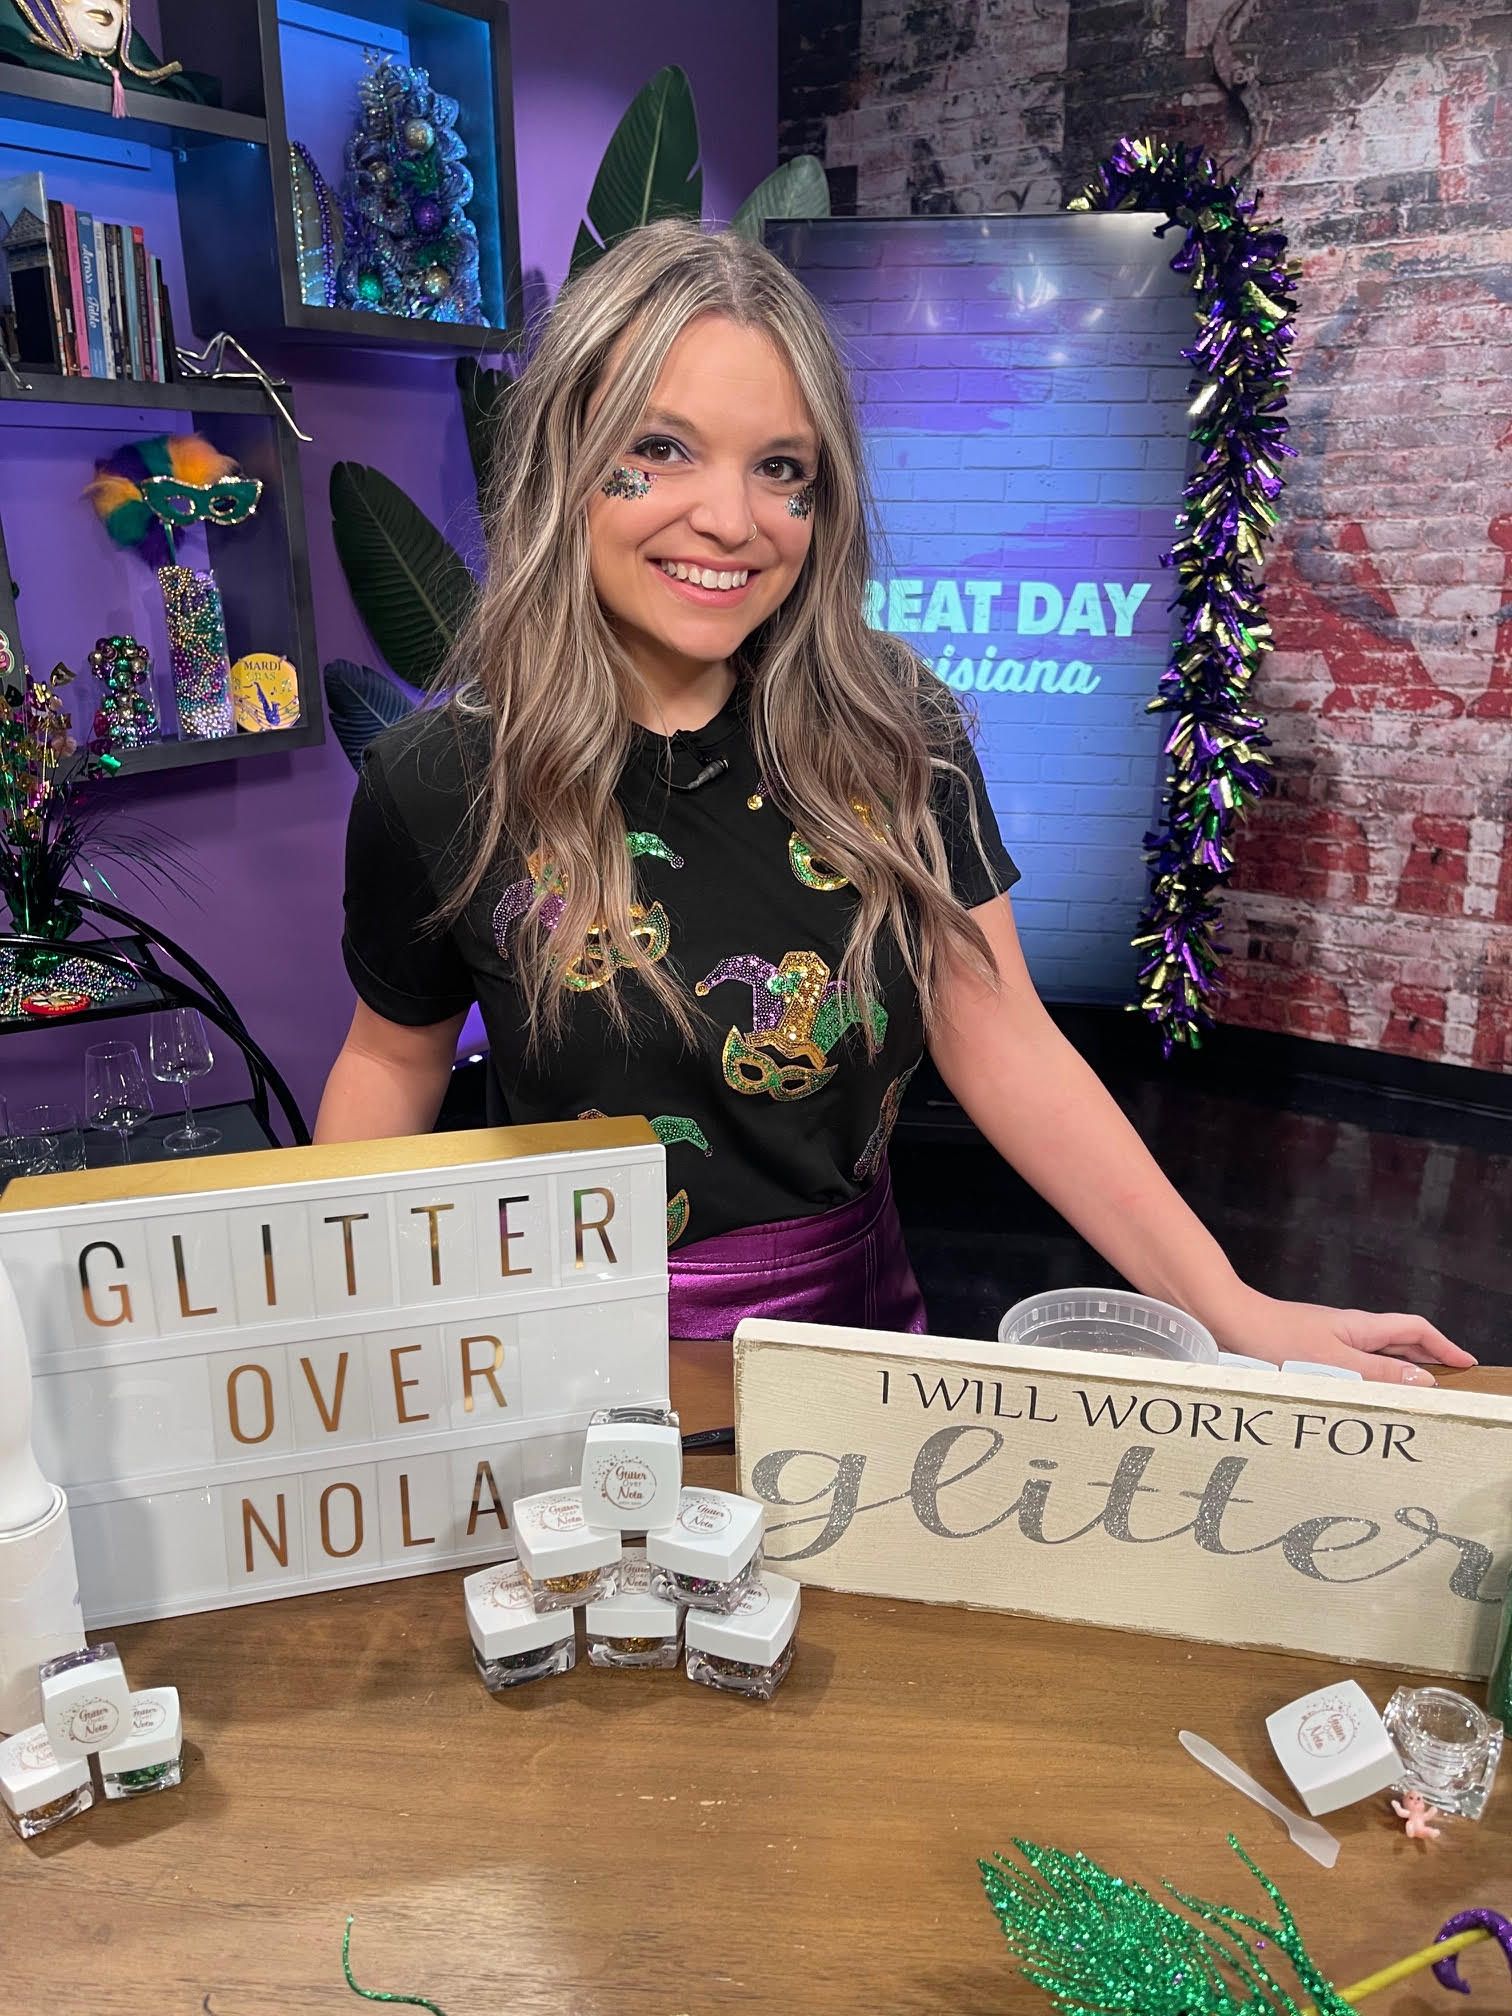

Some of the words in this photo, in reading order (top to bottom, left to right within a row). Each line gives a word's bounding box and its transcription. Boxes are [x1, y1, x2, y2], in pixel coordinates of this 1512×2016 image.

[861, 579, 1002, 634] REAT
[1016, 581, 1152, 637] DAY
[244, 661, 281, 671] MARDI
[924, 644, 1101, 695] isiana
[78, 1186, 618, 1327] GLITTER
[226, 1335, 509, 1444] OVER
[877, 1370, 890, 1405] I
[907, 1372, 1058, 1423] WILL
[1072, 1390, 1273, 1446] WORK
[1291, 1413, 1423, 1463] FOR
[615, 1465, 647, 1480] Glitter
[617, 1486, 643, 1500] Nola
[242, 1460, 510, 1573] NOLA
[697, 1504, 724, 1517] Glitter
[751, 1425, 1500, 1603] glitter
